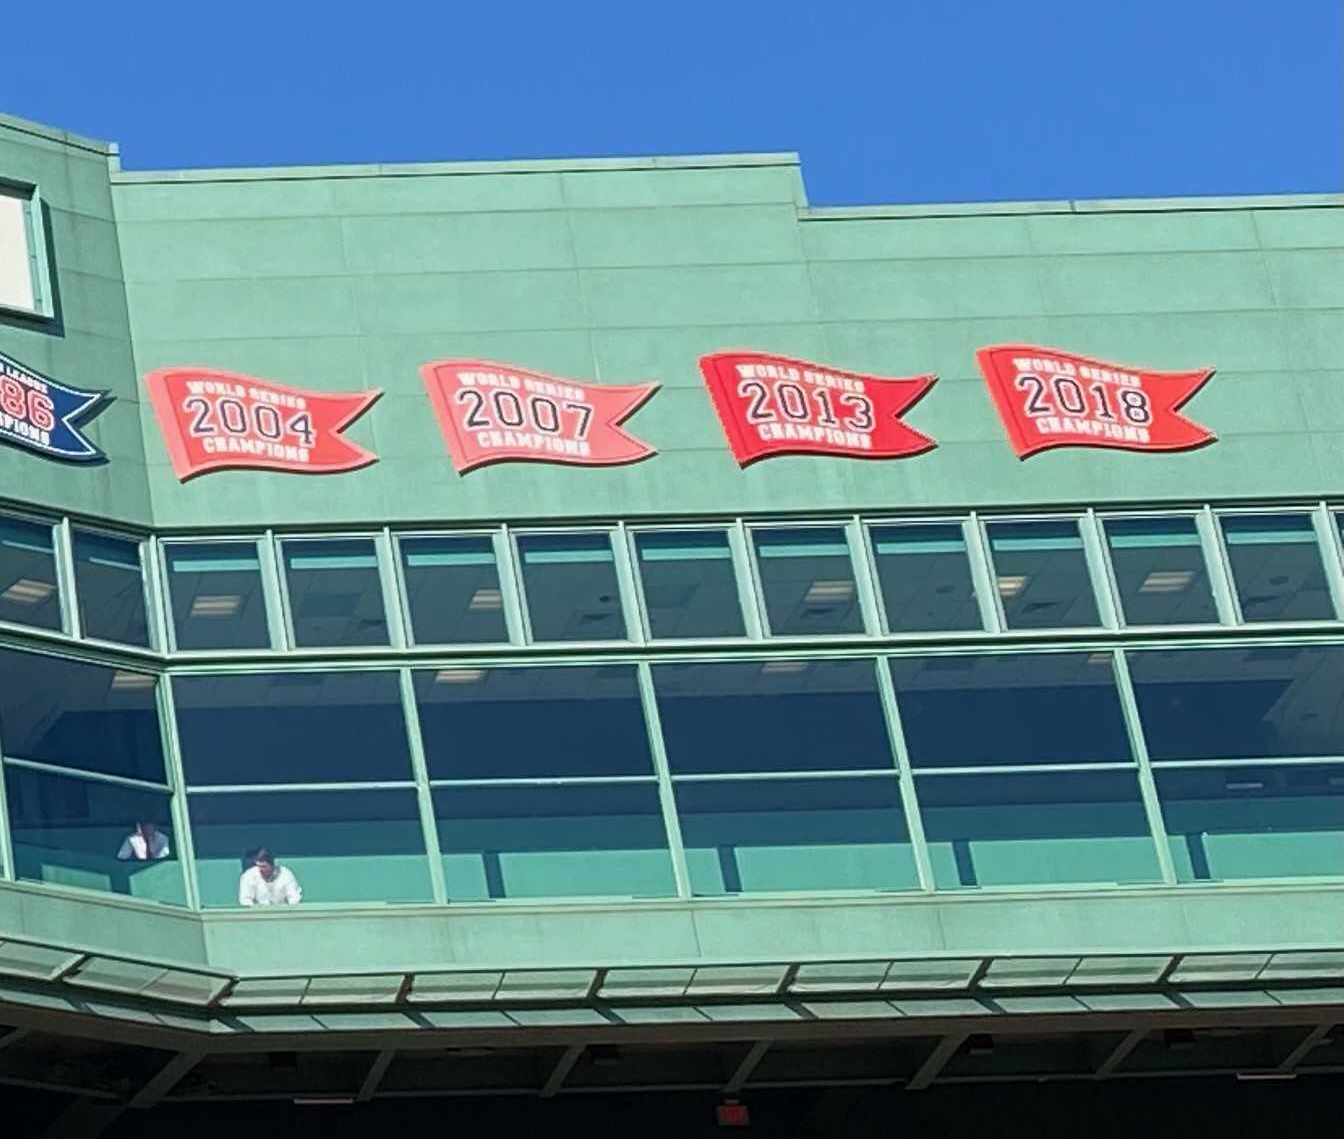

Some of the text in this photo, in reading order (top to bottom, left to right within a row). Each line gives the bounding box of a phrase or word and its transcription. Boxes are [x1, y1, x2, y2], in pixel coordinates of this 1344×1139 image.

[6, 365, 48, 394] LEAGUE
[457, 371, 585, 401] WORLD SERIES
[736, 363, 865, 394] WORLD SERIES
[1012, 357, 1142, 388] WORLD SERIES
[186, 381, 306, 410] WORLD SERIES
[737, 379, 875, 432] 2013
[1015, 373, 1153, 426] 2018
[182, 396, 316, 447] 2004
[456, 387, 594, 440] 2007
[477, 430, 591, 456] CHAMPIONS
[758, 423, 873, 449] CHAMPIONS
[1036, 416, 1150, 444] CHAMPIONS
[203, 436, 309, 462] CHAMPIONS
